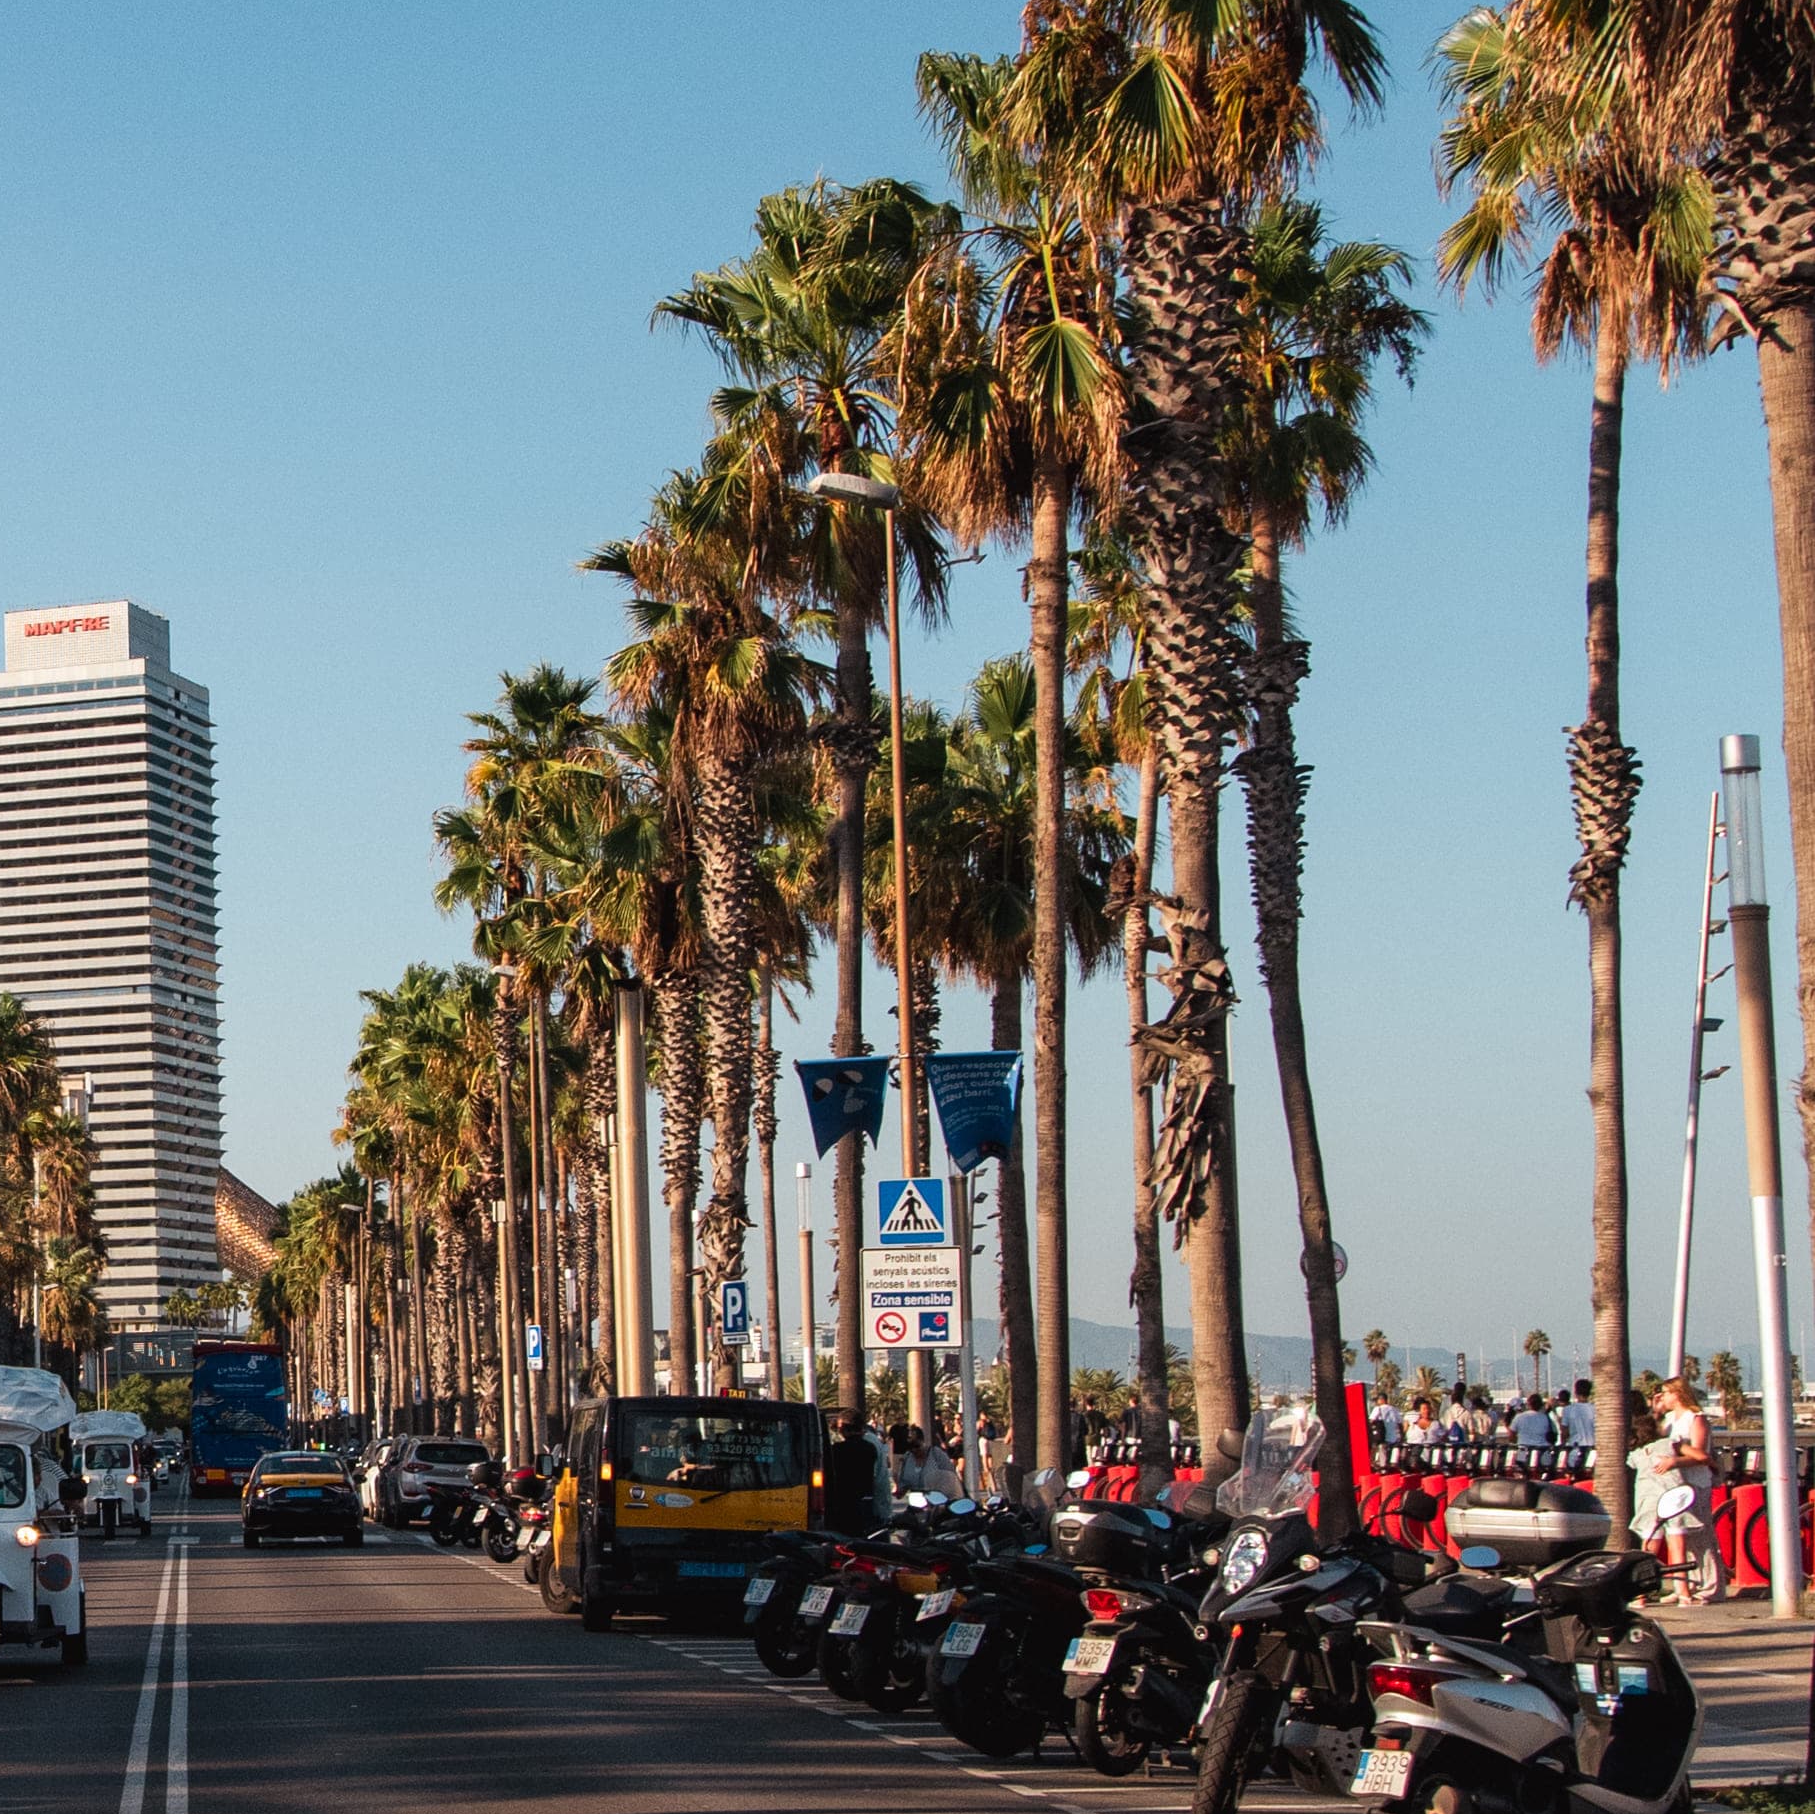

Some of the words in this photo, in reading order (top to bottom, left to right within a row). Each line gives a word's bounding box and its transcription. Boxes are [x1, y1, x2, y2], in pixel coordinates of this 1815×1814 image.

[24, 616, 110, 637] MAPFRE
[884, 1253, 921, 1263] Prohibit
[923, 1252, 937, 1262] els
[872, 1267, 908, 1278] senyals
[911, 1266, 950, 1275] acústics
[866, 1280, 905, 1289] incloses
[907, 1279, 921, 1288] les
[923, 1278, 958, 1288] sirenes
[873, 1294, 902, 1306] Zona
[904, 1293, 951, 1305] sensible
[727, 1287, 742, 1328] P
[529, 1330, 538, 1356] P
[728, 1389, 747, 1398] TAXI
[1078, 1641, 1112, 1656] 9352
[1368, 1754, 1409, 1774] 3939
[1361, 1774, 1393, 1792] HBH
